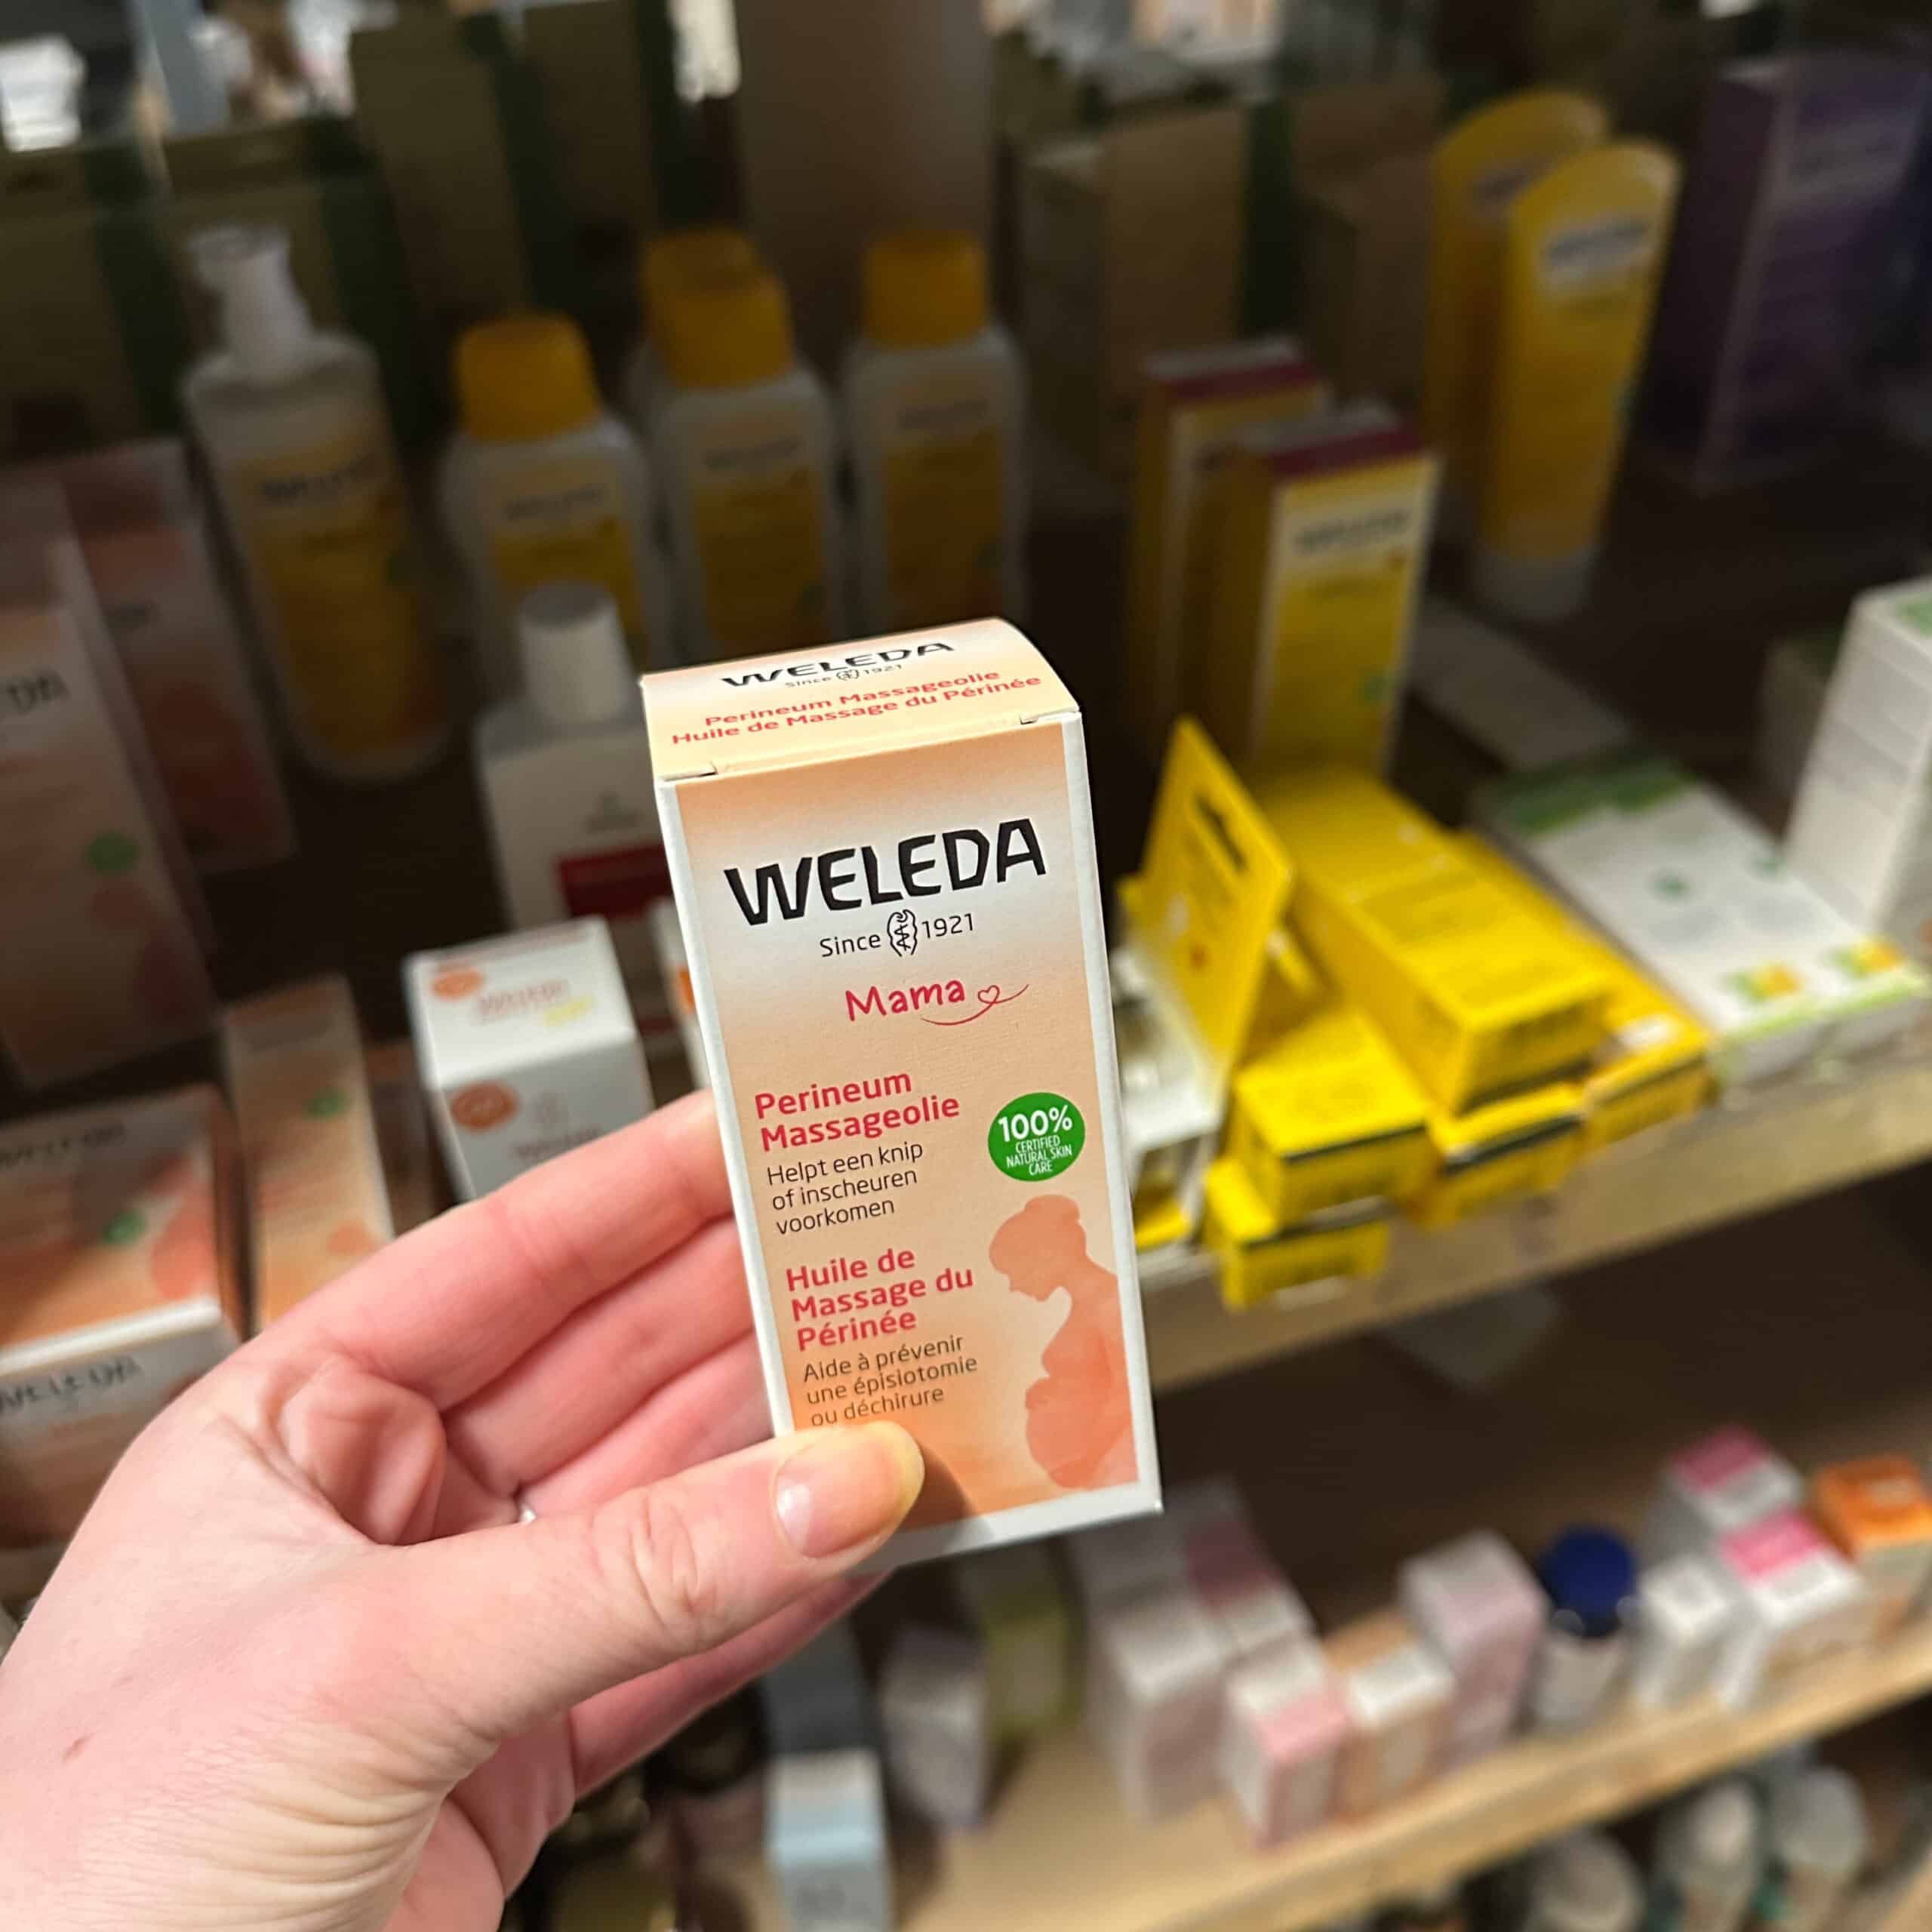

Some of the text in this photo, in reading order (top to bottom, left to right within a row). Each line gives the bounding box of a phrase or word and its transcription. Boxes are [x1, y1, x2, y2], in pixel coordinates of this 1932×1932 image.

[721, 642, 955, 687] WELEDA
[785, 663, 903, 688] Since 1921
[672, 675, 1041, 746] Huile de Massage du Périnée
[704, 670, 1000, 726] Perineum Massageolie
[724, 819, 1046, 925] WELEDA
[820, 913, 974, 957] Since 1921
[845, 979, 965, 1021] Mama
[755, 1072, 912, 1119] Perineum
[761, 1095, 960, 1152] Massageolie
[998, 1105, 1072, 1142] 100%
[1015, 1135, 1060, 1154] CERTIFIED
[767, 1141, 923, 1185] Helpt een knip
[1006, 1144, 1072, 1168] NATURAL SKIN
[1029, 1160, 1053, 1176] CARE
[772, 1170, 917, 1211] of inscheuren
[776, 1199, 895, 1235] voorkomen
[786, 1248, 915, 1292] Huile de
[791, 1267, 974, 1321] Massage du
[797, 1310, 916, 1351] Périnée
[804, 1334, 964, 1383] Aide à prévenir
[807, 1356, 978, 1404] une épisiotomie
[811, 1387, 944, 1426] ou déchirure
